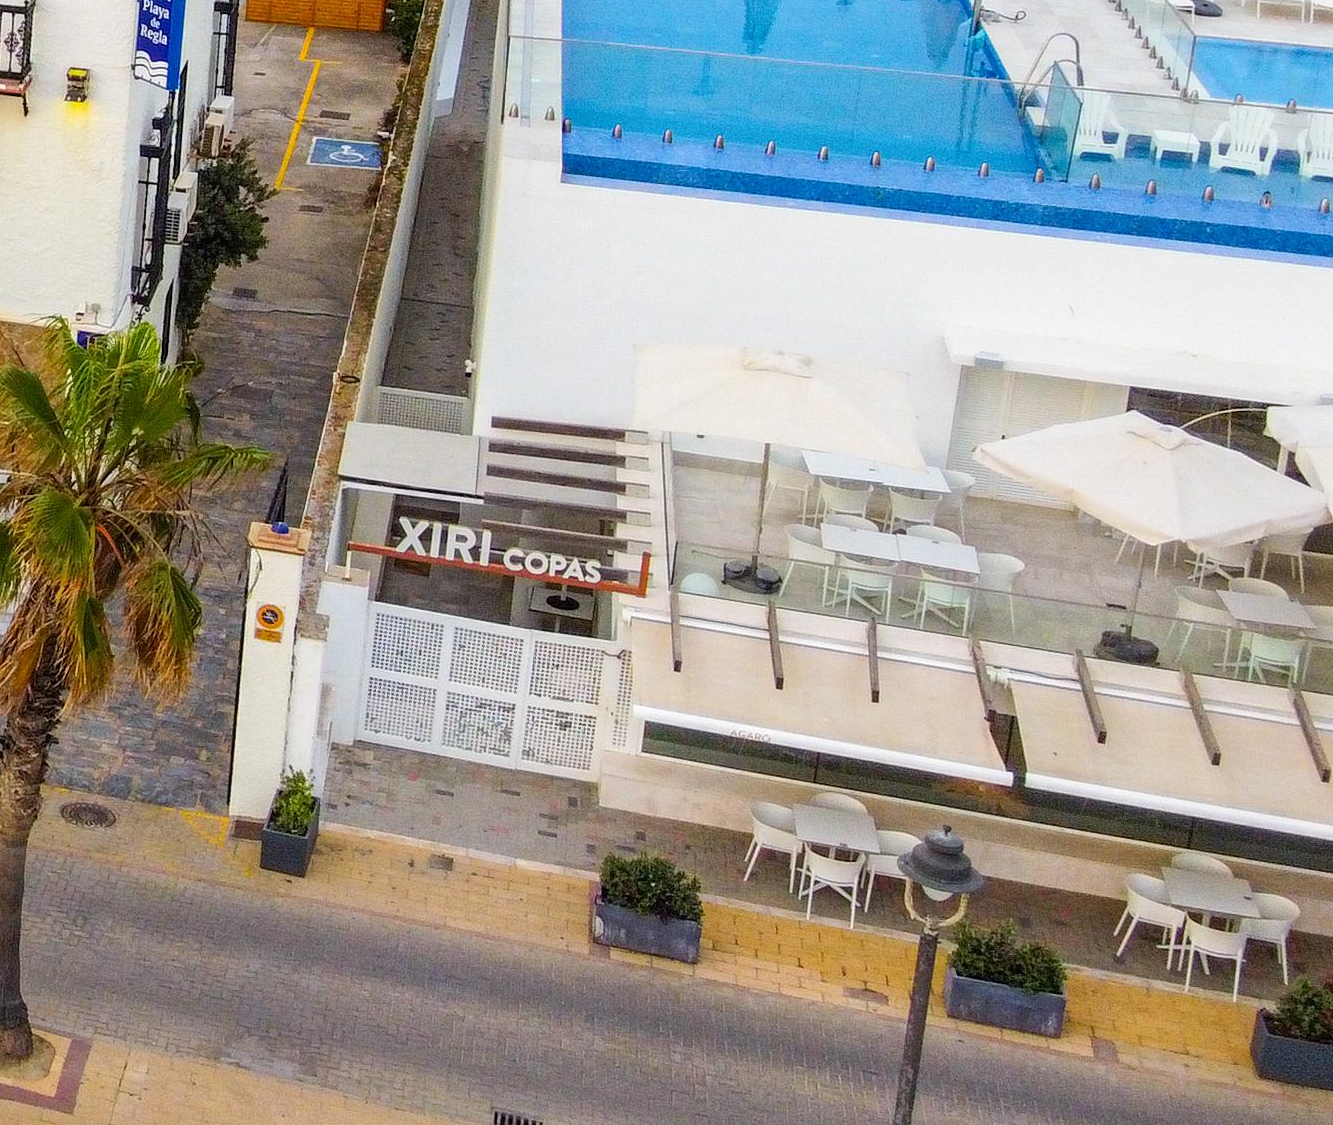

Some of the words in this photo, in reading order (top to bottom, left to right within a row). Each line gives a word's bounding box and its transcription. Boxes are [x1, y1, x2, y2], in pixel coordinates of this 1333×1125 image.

[142, 0, 170, 20] Playa
[150, 18, 161, 29] de
[140, 24, 169, 46] Regla
[395, 517, 491, 567] XIRI
[503, 549, 602, 584] COPAS
